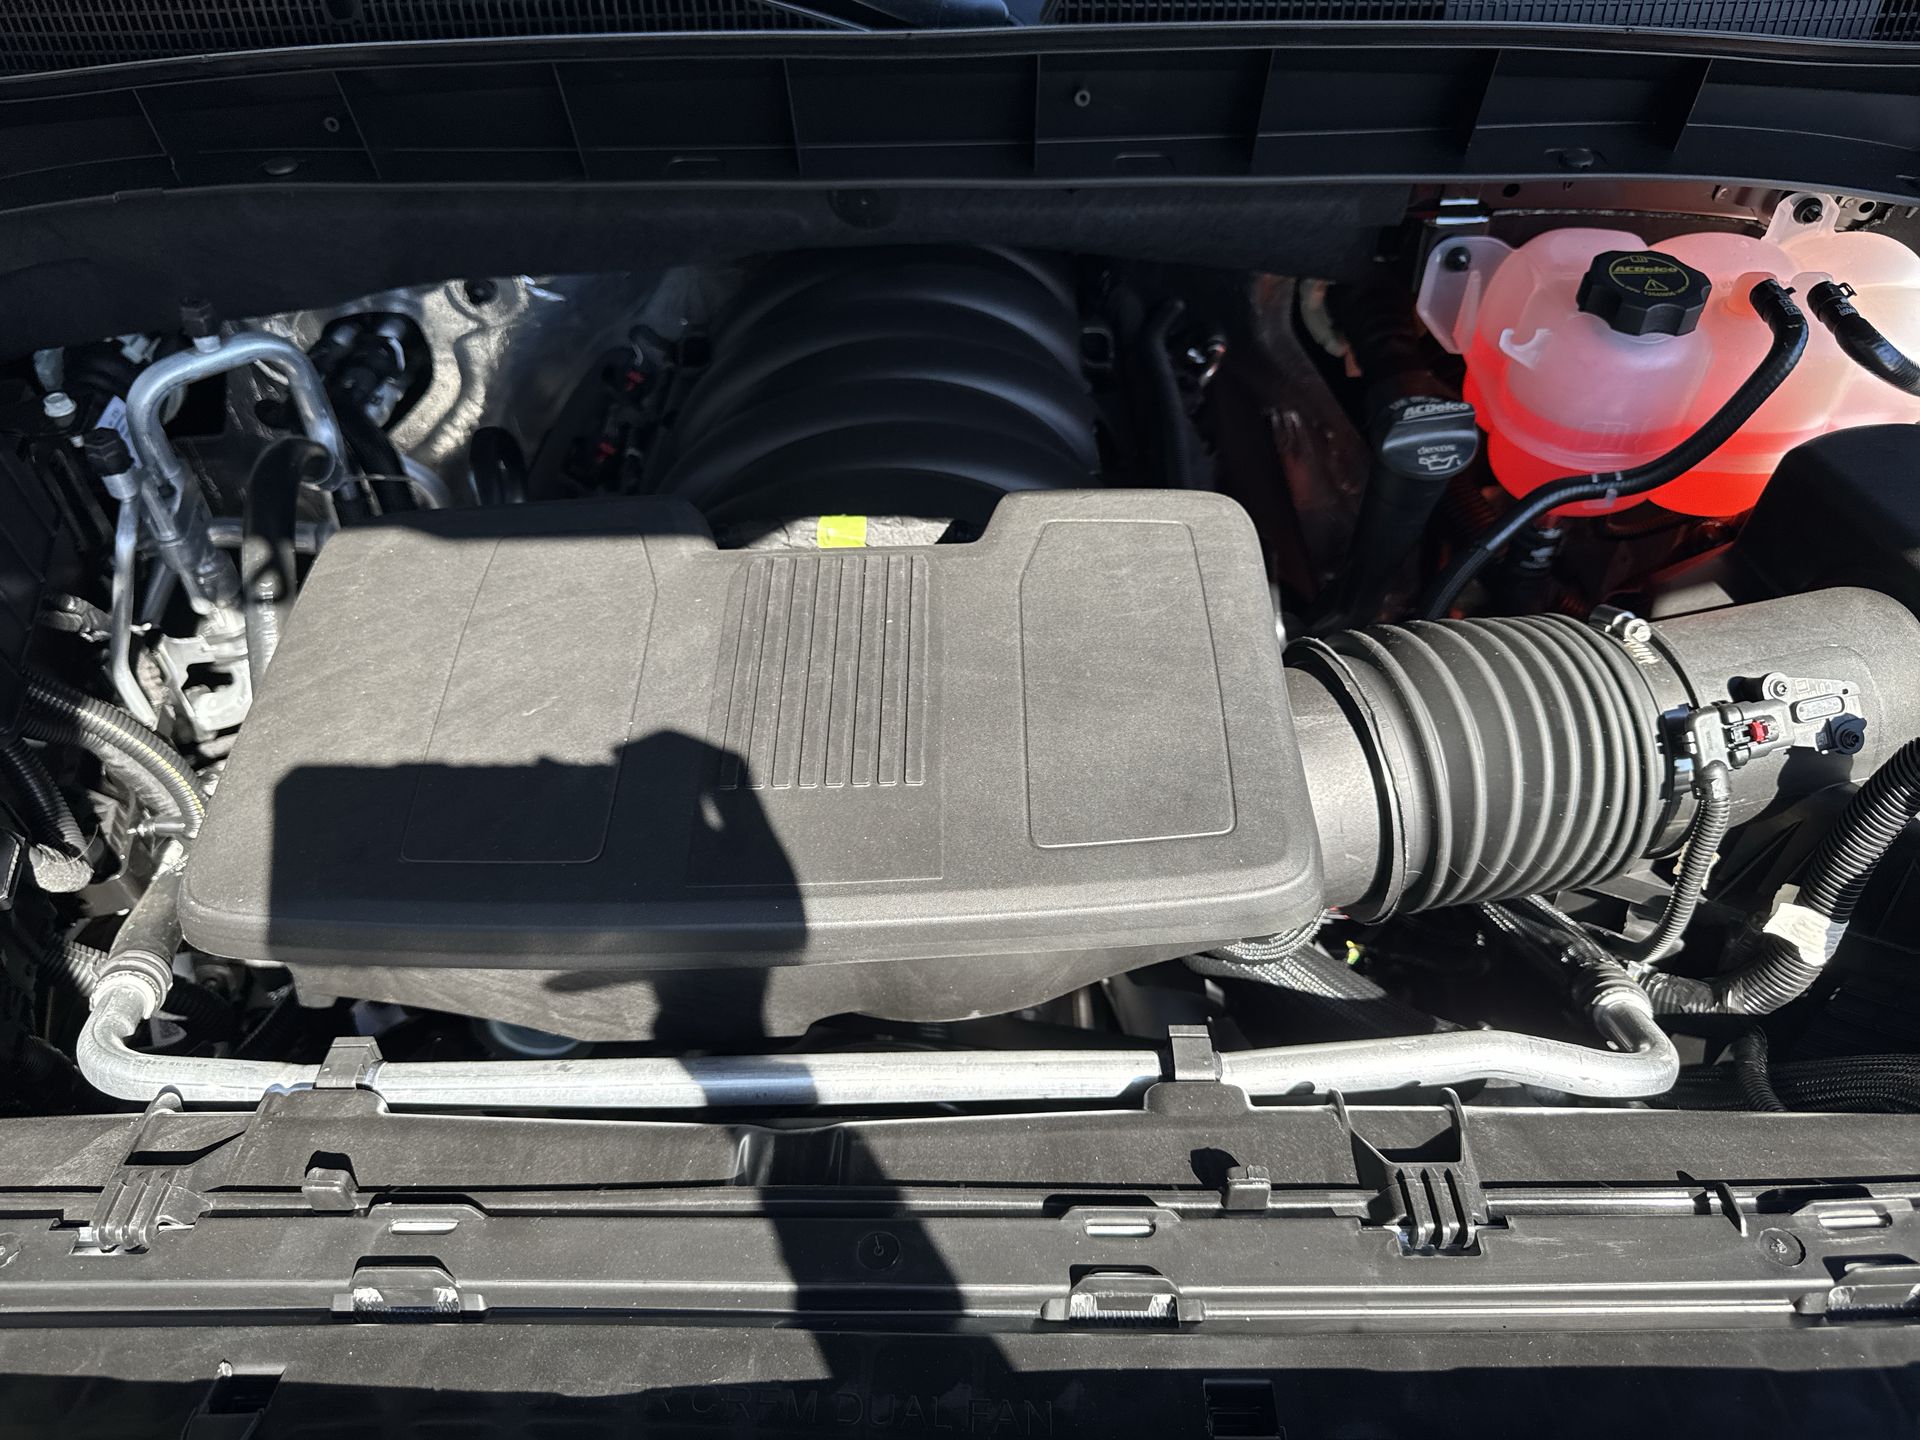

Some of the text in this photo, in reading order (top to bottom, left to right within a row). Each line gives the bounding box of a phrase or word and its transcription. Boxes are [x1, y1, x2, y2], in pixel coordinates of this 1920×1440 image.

[1613, 265, 1679, 274] ACDelco
[1402, 401, 1471, 419] ACDelco
[1416, 444, 1456, 456] dexos
[835, 1391, 953, 1430] DUAL
[968, 1396, 1055, 1437] FAN
